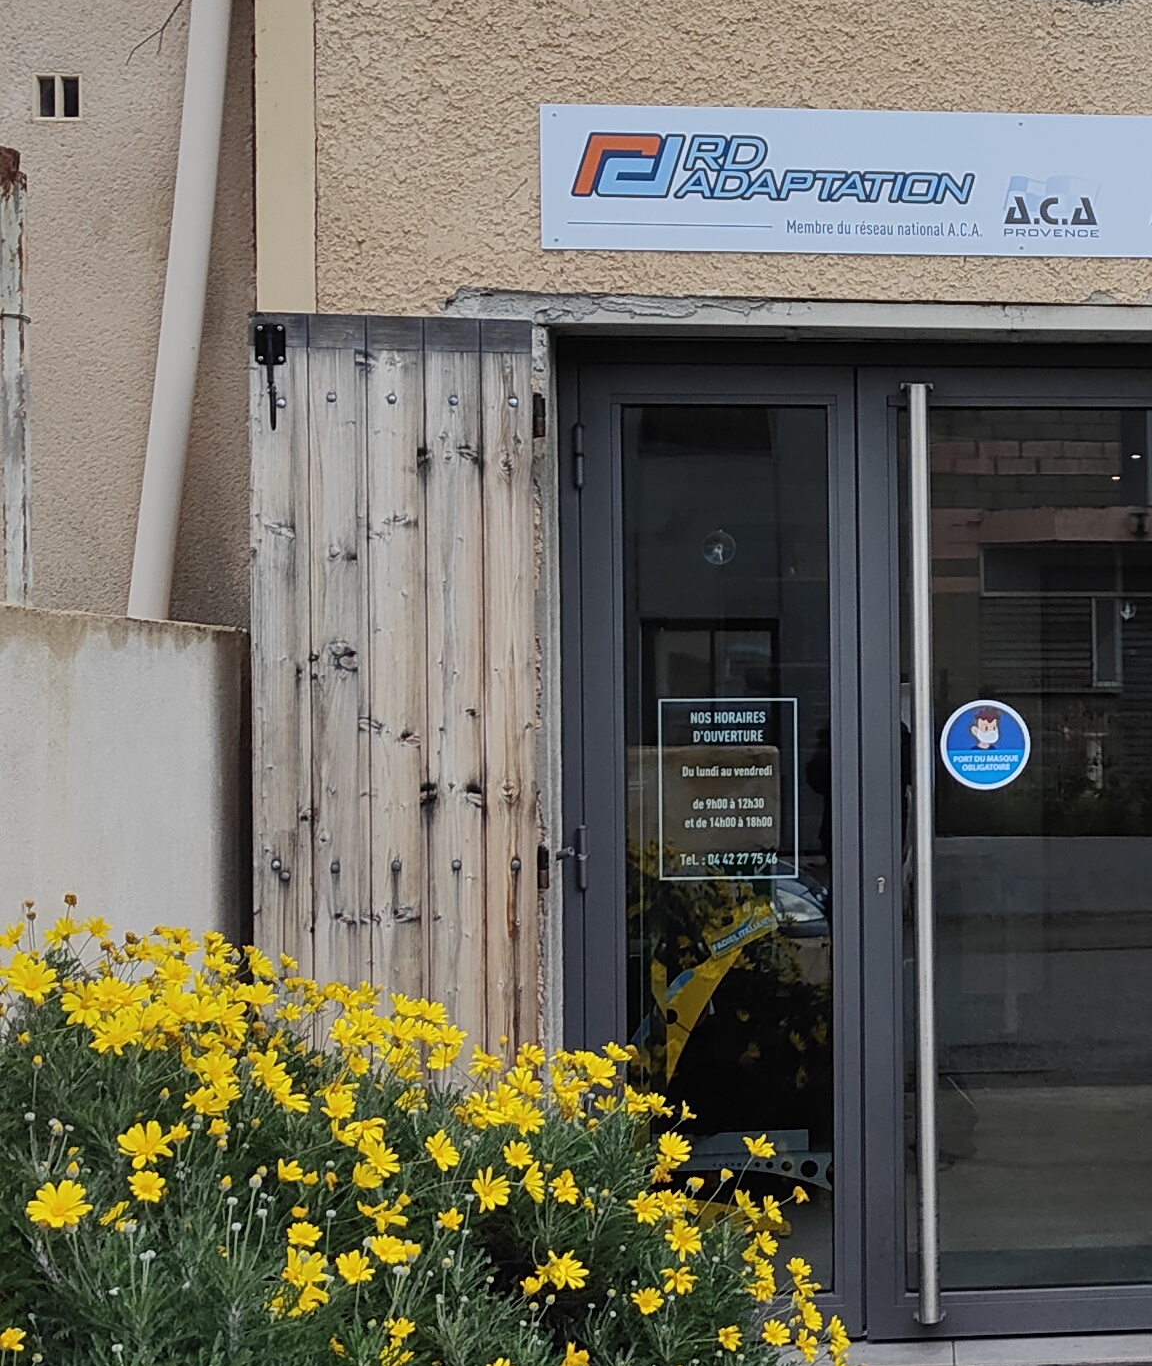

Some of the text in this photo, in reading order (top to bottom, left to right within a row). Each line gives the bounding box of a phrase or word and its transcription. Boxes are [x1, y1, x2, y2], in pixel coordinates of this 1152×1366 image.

[683, 133, 768, 172] RD
[673, 168, 976, 205] ADAPTATION
[786, 219, 984, 239] Membre du réseau national A.C.A.
[1002, 227, 1100, 239] PROVENCE
[690, 711, 767, 724] NOS HORAIRES
[693, 729, 764, 743] D'OUVERTURE
[953, 755, 1019, 763] PORT DU MASQUE
[682, 765, 773, 777] Du lundi au vendredi
[962, 763, 1010, 772] OBLIGATOIRE
[692, 797, 765, 810] de 9h00 à 12h30
[684, 815, 773, 828] et de 14h00 à 18h00
[707, 853, 720, 866] 04
[722, 853, 735, 866] 42
[736, 853, 749, 866] 27
[750, 853, 763, 865] 75
[765, 852, 778, 865] 46
